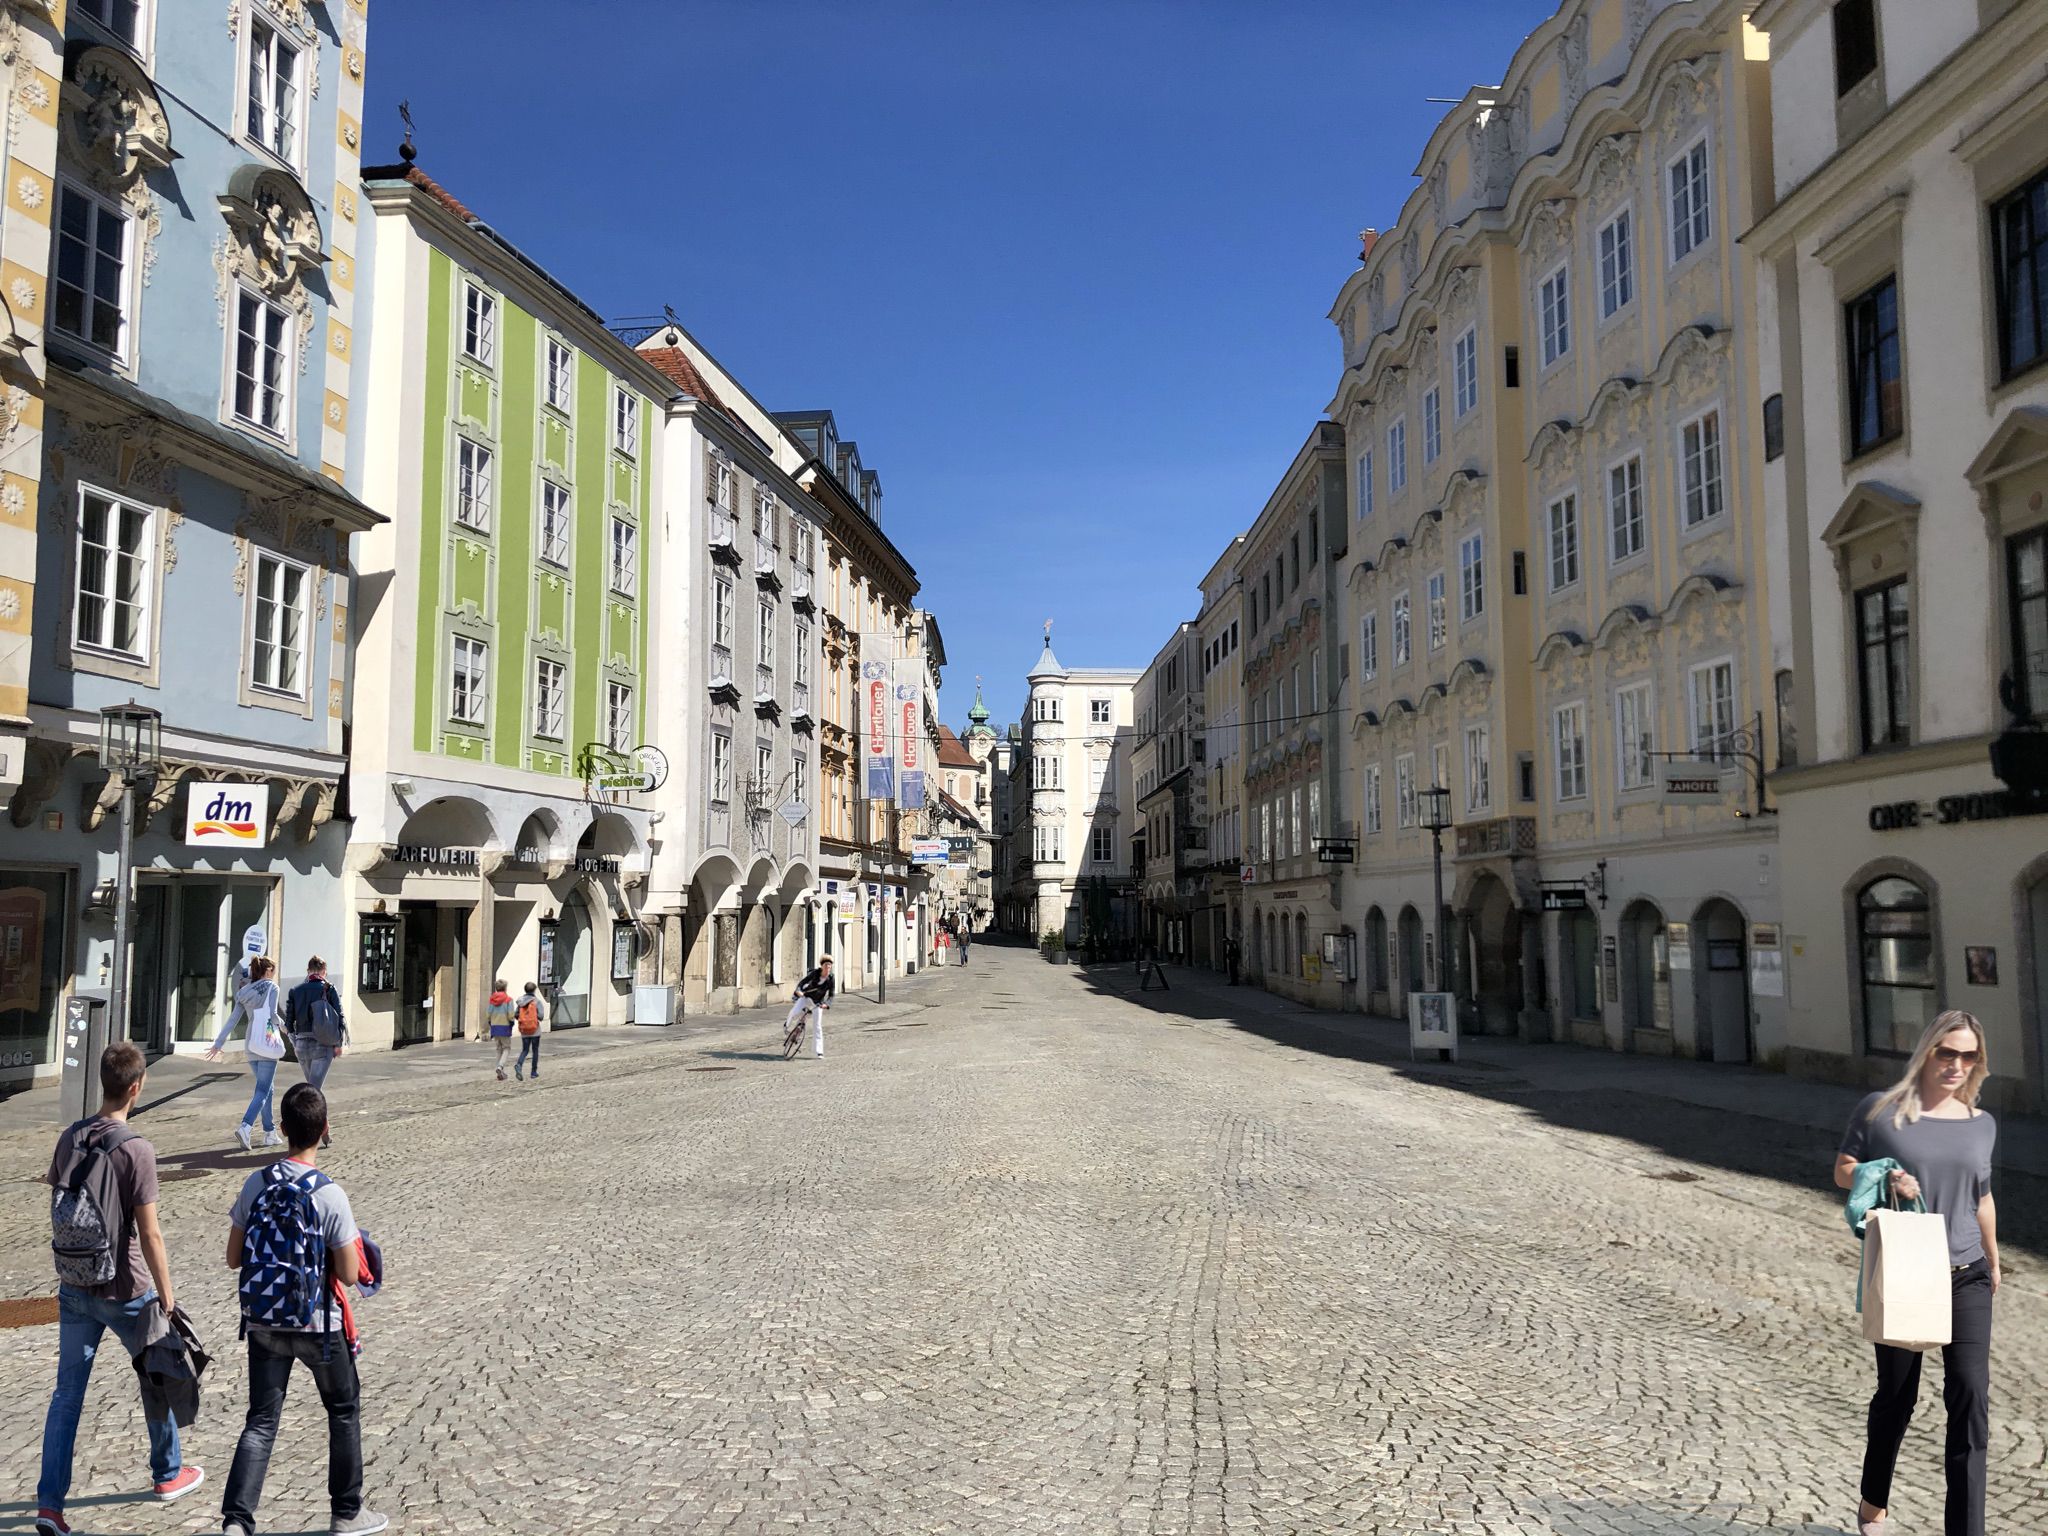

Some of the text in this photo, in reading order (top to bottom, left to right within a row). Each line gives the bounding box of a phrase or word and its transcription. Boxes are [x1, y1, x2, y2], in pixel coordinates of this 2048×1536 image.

[872, 685, 884, 748] Hartlauer
[904, 706, 916, 763] Hartlauer
[600, 776, 645, 789] pfeiffer
[205, 792, 252, 821] dm
